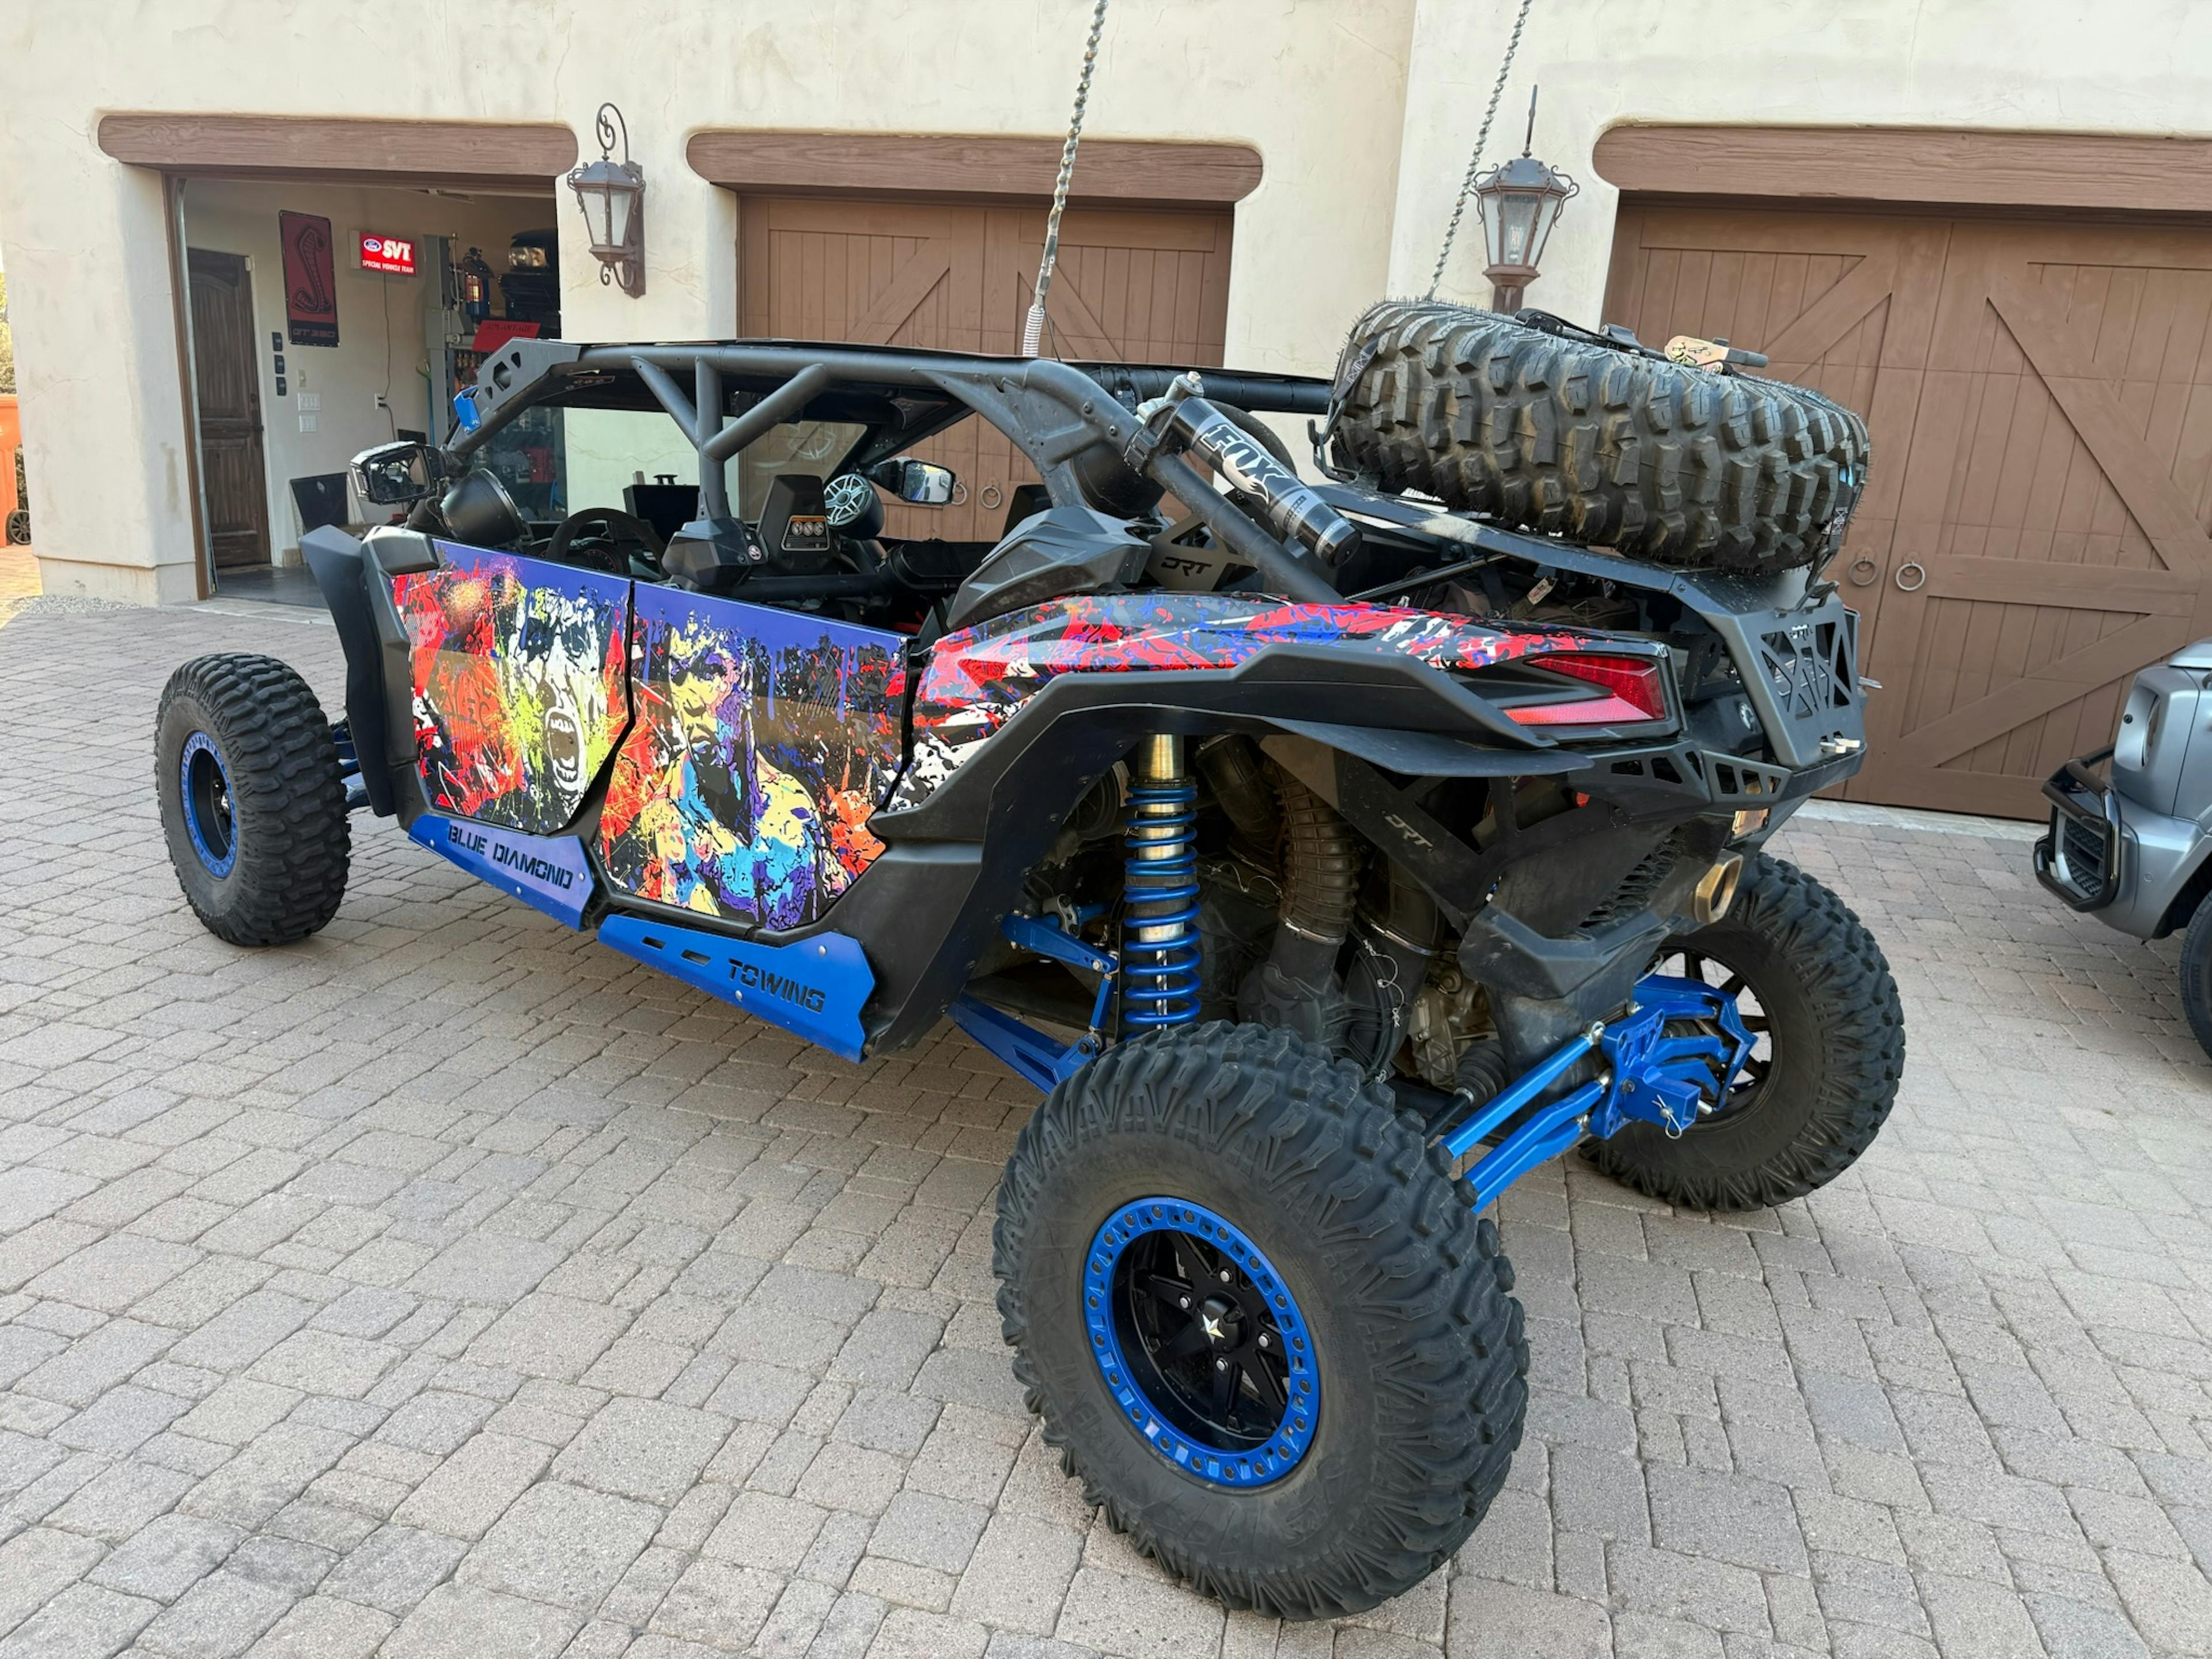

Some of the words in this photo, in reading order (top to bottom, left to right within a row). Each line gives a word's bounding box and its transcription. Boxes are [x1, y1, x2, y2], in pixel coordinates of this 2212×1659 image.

[362, 260, 381, 268] SPECIAL
[382, 263, 401, 271] VEHICLE
[402, 265, 414, 273] TEAM
[382, 239, 411, 262] SVT
[1200, 424, 1289, 485] FOX
[1161, 557, 1212, 576] DRT
[1385, 813, 1433, 847] DRT
[448, 826, 487, 856] BLUE
[493, 842, 573, 890] DIAMOND
[729, 959, 825, 1013] TOWING
